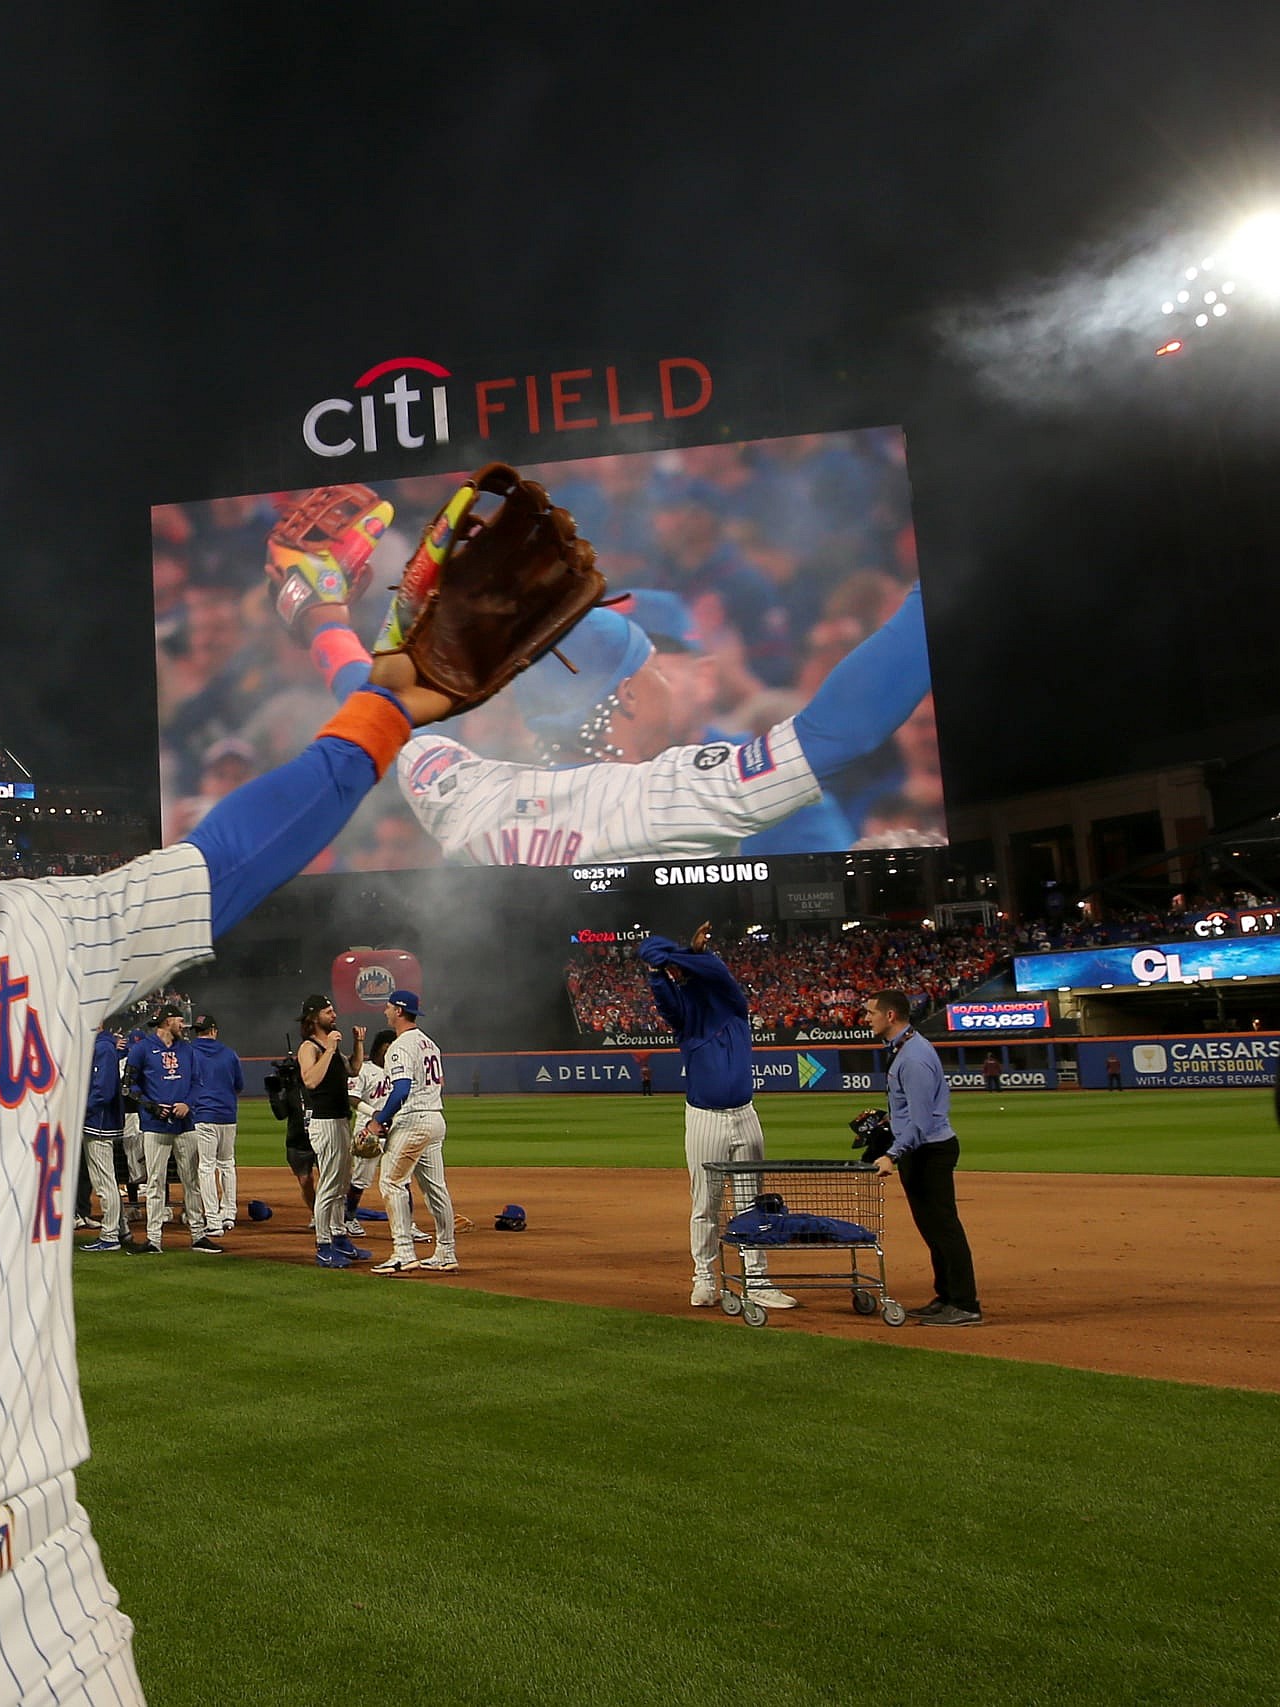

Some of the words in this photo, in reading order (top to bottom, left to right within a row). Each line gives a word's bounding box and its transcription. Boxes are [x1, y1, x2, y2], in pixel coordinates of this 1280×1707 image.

[303, 374, 449, 458] citi
[476, 357, 713, 441] FIELD
[573, 868, 605, 880] 08:25
[607, 867, 625, 879] PM
[655, 862, 769, 886] SAMSUNG
[578, 928, 615, 943] Coors
[616, 930, 651, 941] LIGHT
[952, 1005, 987, 1014] 50/50
[989, 1003, 1043, 1013] JACKPOT
[961, 1013, 1035, 1028] $73,625
[616, 1033, 648, 1045] Coors
[810, 1027, 842, 1040] Coors
[843, 1029, 875, 1040] LIGHT
[1171, 1041, 1280, 1060] CAESARS
[423, 1055, 441, 1086] 20
[559, 1065, 631, 1080] DELTA
[1173, 1060, 1265, 1073] SPORTSBOOK
[842, 1075, 871, 1089] 380
[1000, 1073, 1045, 1086] GOYA
[1136, 1076, 1166, 1086] WITH
[1170, 1075, 1224, 1086] CAESARS
